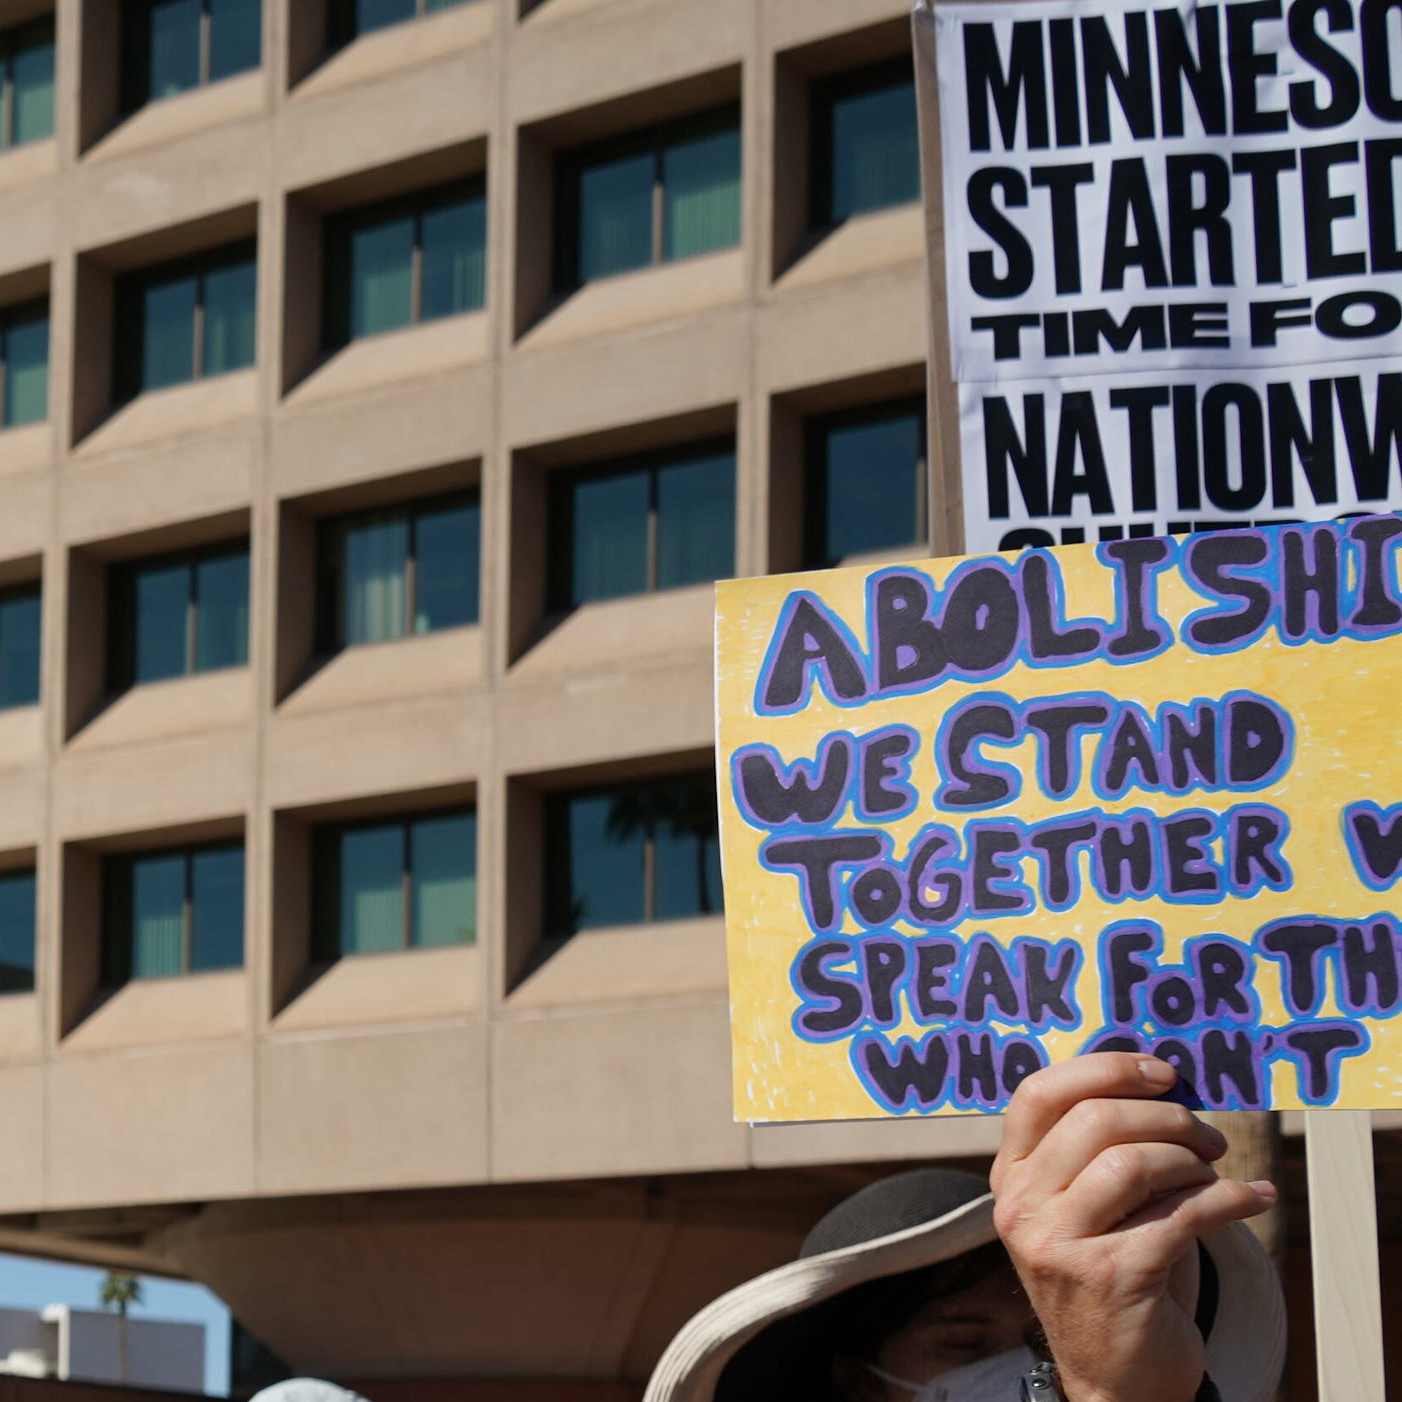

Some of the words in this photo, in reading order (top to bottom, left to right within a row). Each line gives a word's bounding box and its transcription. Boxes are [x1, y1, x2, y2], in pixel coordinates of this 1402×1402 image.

[970, 301, 1230, 360] TIME
[733, 722, 920, 828] WE
[936, 692, 1292, 810] STAND
[758, 804, 1290, 933] TOGETHER
[794, 935, 1080, 1040] SPEAK
[1100, 920, 1256, 1030] FOR
[854, 1026, 1044, 1108] WHO
